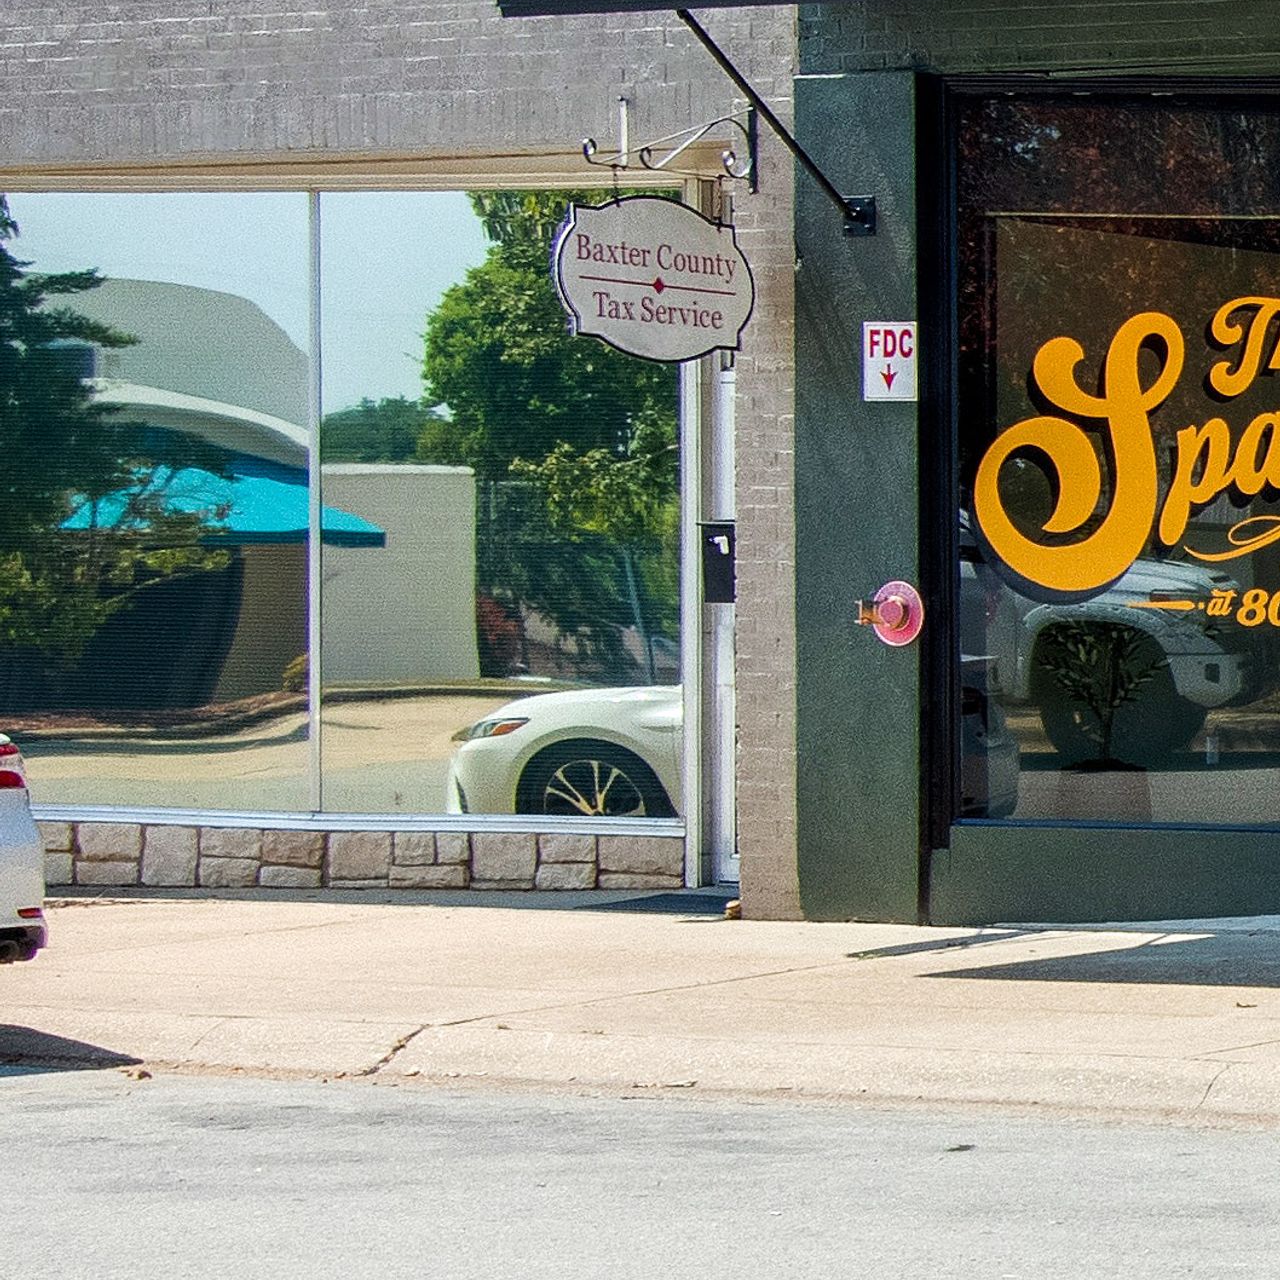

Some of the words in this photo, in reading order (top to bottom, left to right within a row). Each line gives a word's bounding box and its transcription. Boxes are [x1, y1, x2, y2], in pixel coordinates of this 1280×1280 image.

[576, 233, 650, 268] Baxter
[656, 244, 737, 285] County
[593, 291, 634, 320] Tax
[641, 296, 723, 330] Service
[868, 328, 914, 358] FDC
[1207, 589, 1237, 616] at
